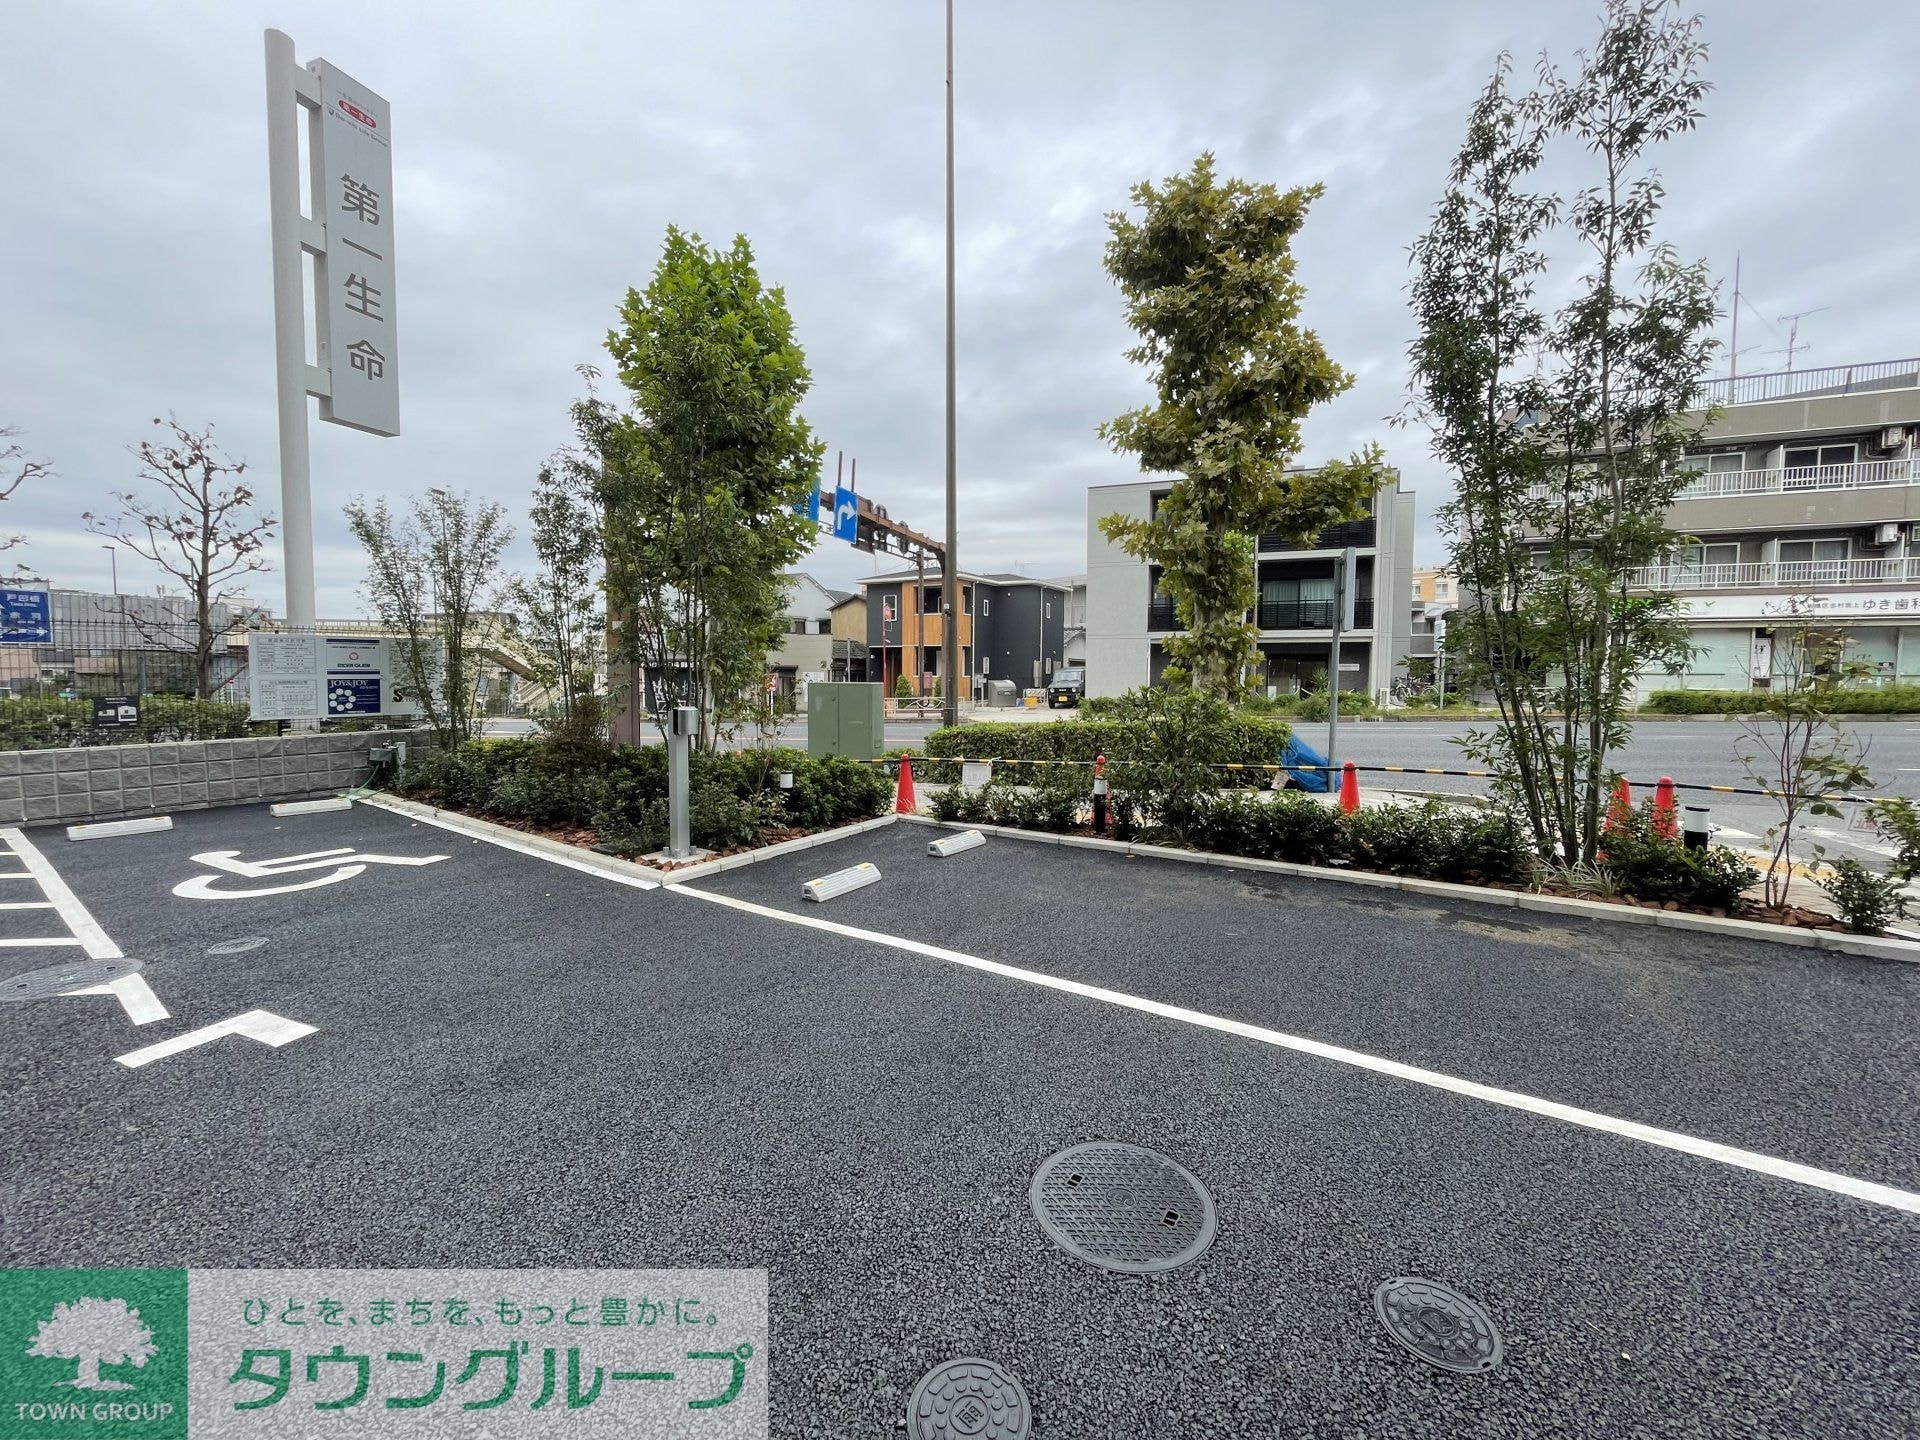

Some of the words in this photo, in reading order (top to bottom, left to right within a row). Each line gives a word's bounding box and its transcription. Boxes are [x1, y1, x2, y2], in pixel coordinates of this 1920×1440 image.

[340, 173, 386, 381] 第一生命
[329, 679, 369, 689] JOY&JOY
